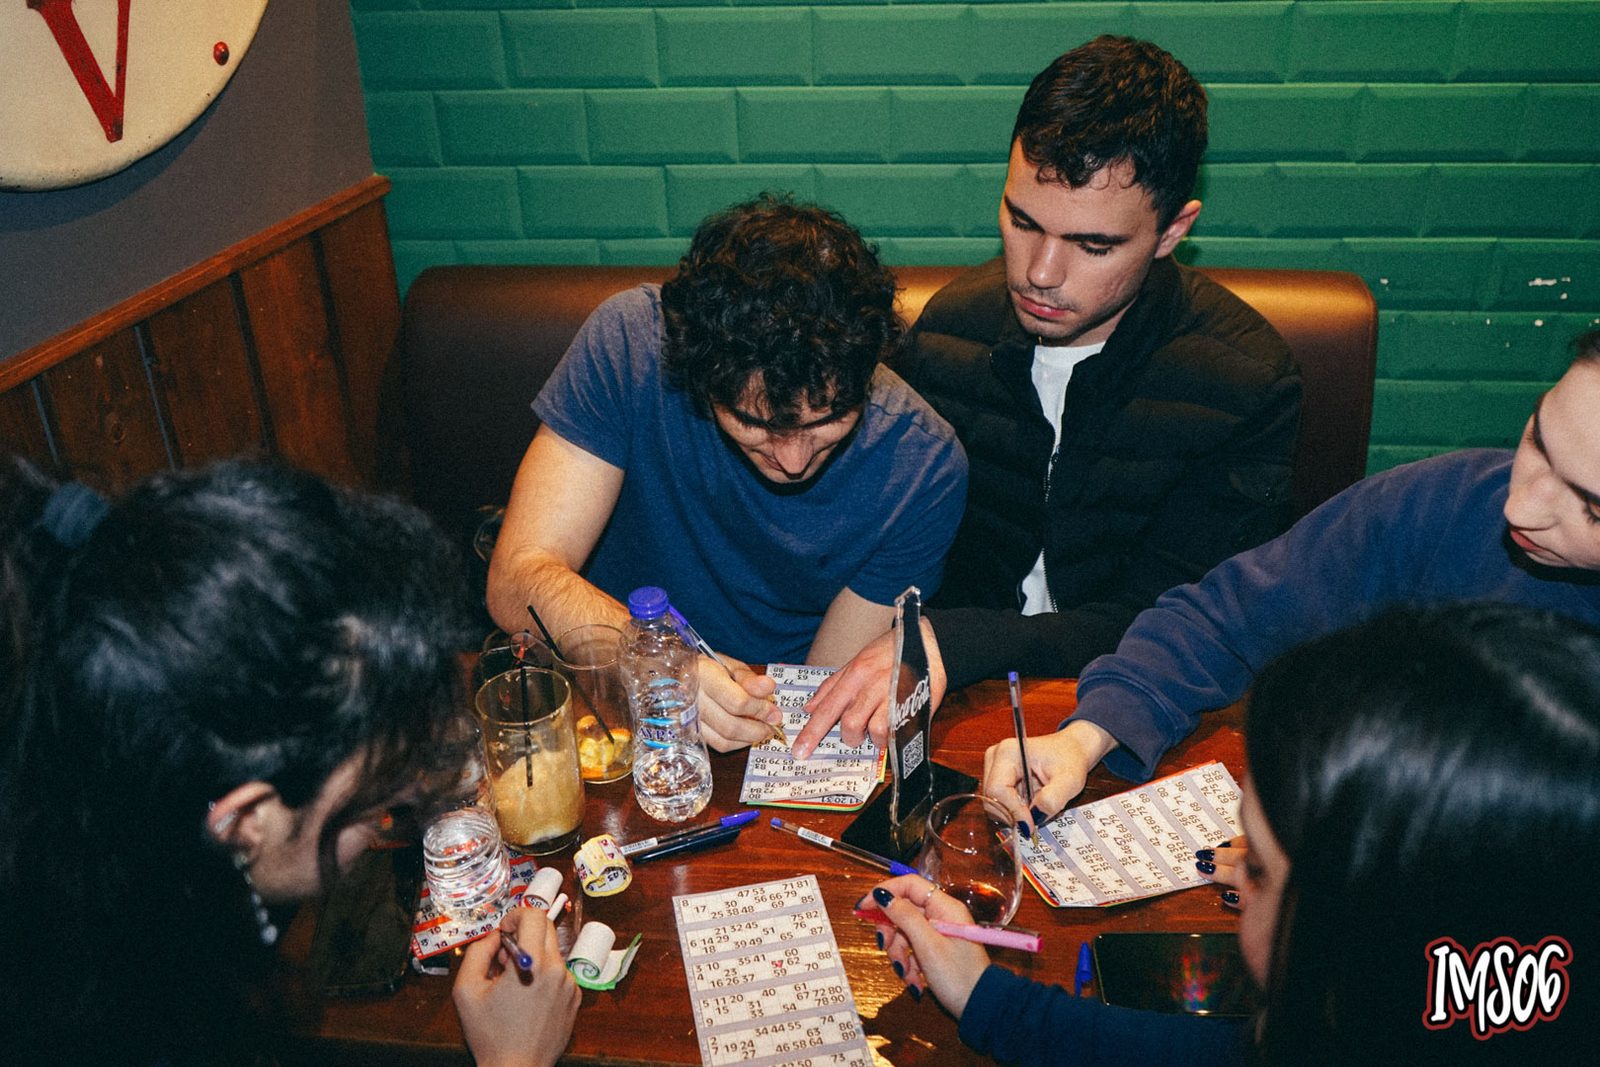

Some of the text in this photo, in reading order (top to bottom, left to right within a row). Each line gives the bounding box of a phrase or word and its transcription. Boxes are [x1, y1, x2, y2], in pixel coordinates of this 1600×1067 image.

[1201, 786, 1212, 796] 74
[1202, 772, 1229, 804] 62 75 82
[1211, 770, 1238, 800] 66 85
[1121, 800, 1134, 811] 81
[1139, 793, 1150, 804] 89
[1157, 787, 1191, 826] 56 61 80
[1175, 782, 1202, 812] 68 86
[1099, 818, 1111, 826] 77
[1109, 814, 1120, 824] 79
[1127, 809, 1138, 818] 70
[1174, 796, 1216, 842] 33 44 59 71
[1216, 807, 1228, 816] 52
[1116, 824, 1128, 833] 64
[1123, 833, 1135, 842] 58
[1136, 806, 1187, 863] 26 30 53 60 73
[1083, 810, 1146, 884] 11 36 63 88
[1121, 845, 1132, 854] 46
[1149, 837, 1160, 846] 42
[1176, 842, 1188, 850] 32
[1128, 856, 1140, 864] 37
[1184, 852, 1197, 860] 27
[1172, 866, 1184, 876] 19
[752, 888, 765, 896] 53
[782, 883, 795, 892] 71
[796, 880, 808, 888] 81
[711, 911, 723, 919] 25
[726, 908, 739, 916] 38
[772, 900, 784, 908] 69
[801, 895, 814, 904] 85
[724, 900, 737, 909] 30
[754, 895, 767, 903] 56
[784, 890, 797, 898] 79
[429, 927, 441, 935] 10
[714, 927, 728, 936] 21
[730, 924, 742, 932] 32
[806, 911, 818, 919] 82
[716, 935, 729, 943] 29
[763, 927, 775, 935] 51
[793, 921, 806, 929] 76
[703, 946, 716, 954] 18
[734, 940, 746, 949] 39
[780, 932, 793, 940] 65
[810, 926, 823, 935] 87
[708, 962, 719, 970] 10
[738, 957, 751, 966] 35
[754, 954, 766, 962] 41
[785, 948, 798, 957] 60
[724, 968, 737, 977] 23
[787, 957, 800, 965] 62
[818, 951, 832, 960] 88
[711, 962, 818, 988] 16 26 37 59 70
[703, 983, 806, 1008] 5 11 20 40 61
[716, 986, 842, 1014] 15 31 67 72 80
[707, 994, 845, 1026] 9 33 54 78 90
[711, 1015, 834, 1046] 2 34 44 55 74
[712, 1022, 853, 1055] 7 19 24 63 86
[742, 1031, 856, 1059] 27 46 58 64 89
[798, 1054, 845, 1067] 50 73
